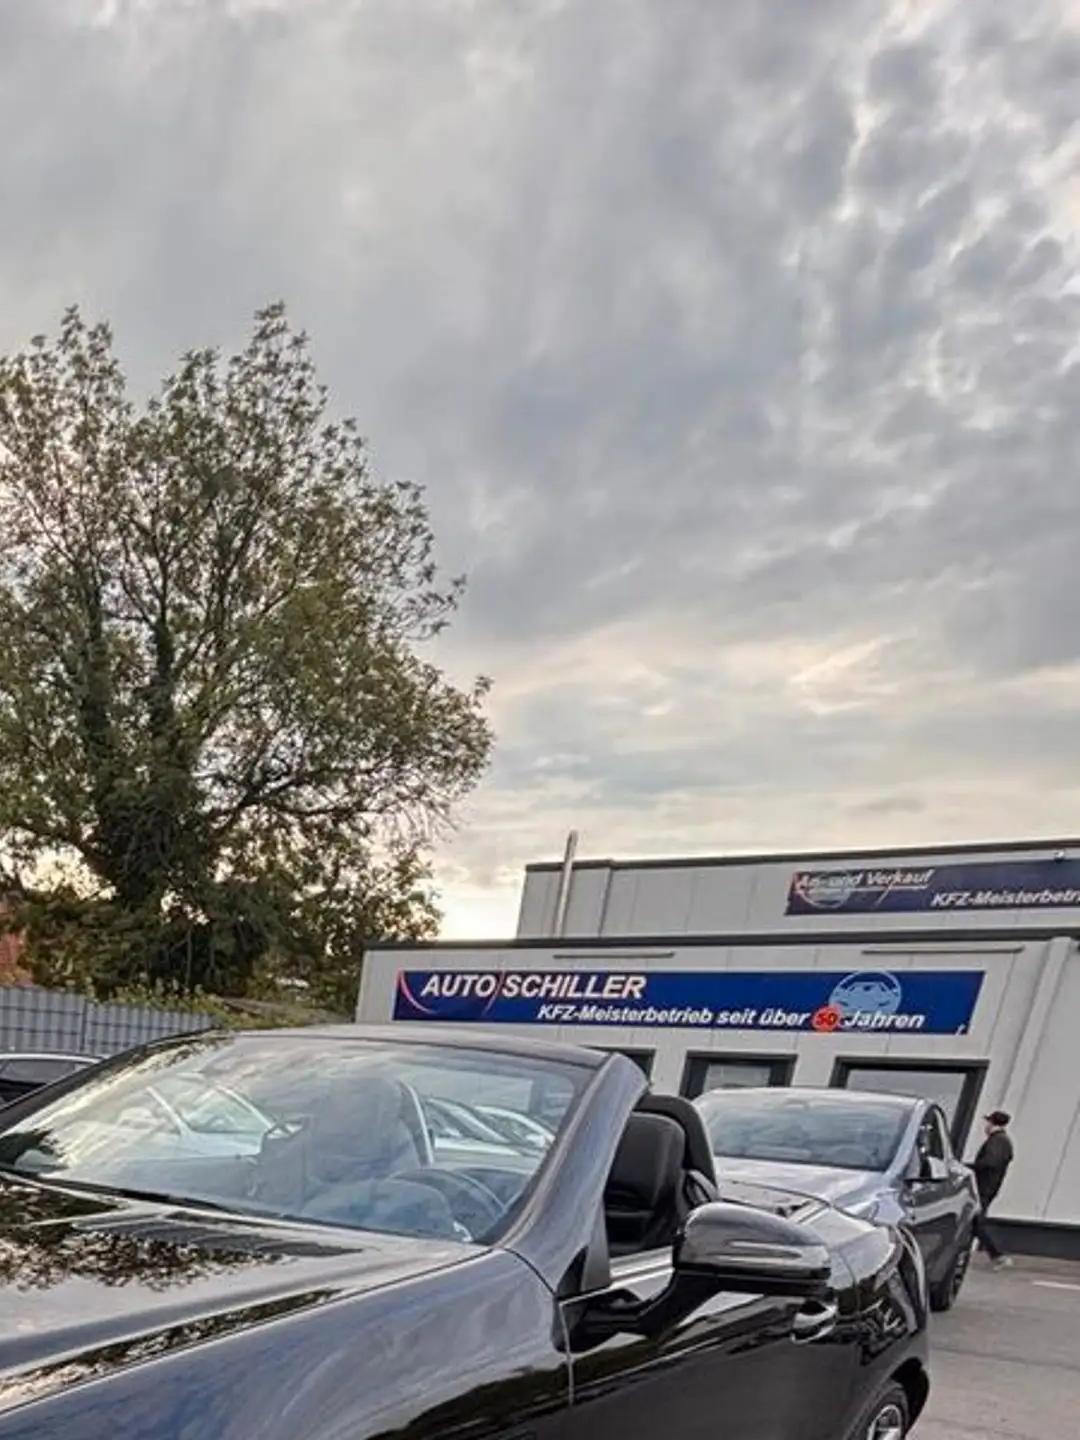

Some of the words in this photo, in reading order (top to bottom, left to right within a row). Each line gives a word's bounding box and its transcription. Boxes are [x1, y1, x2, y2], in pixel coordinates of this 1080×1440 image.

[867, 868, 936, 885] Verkauf
[420, 973, 496, 998] AUTO
[501, 973, 646, 1000] SCHILLER
[537, 1003, 713, 1024] KFZ-Meisterbetrieb
[717, 1007, 757, 1025] seit
[759, 1007, 811, 1026] über
[843, 1009, 925, 1029] Jahren
